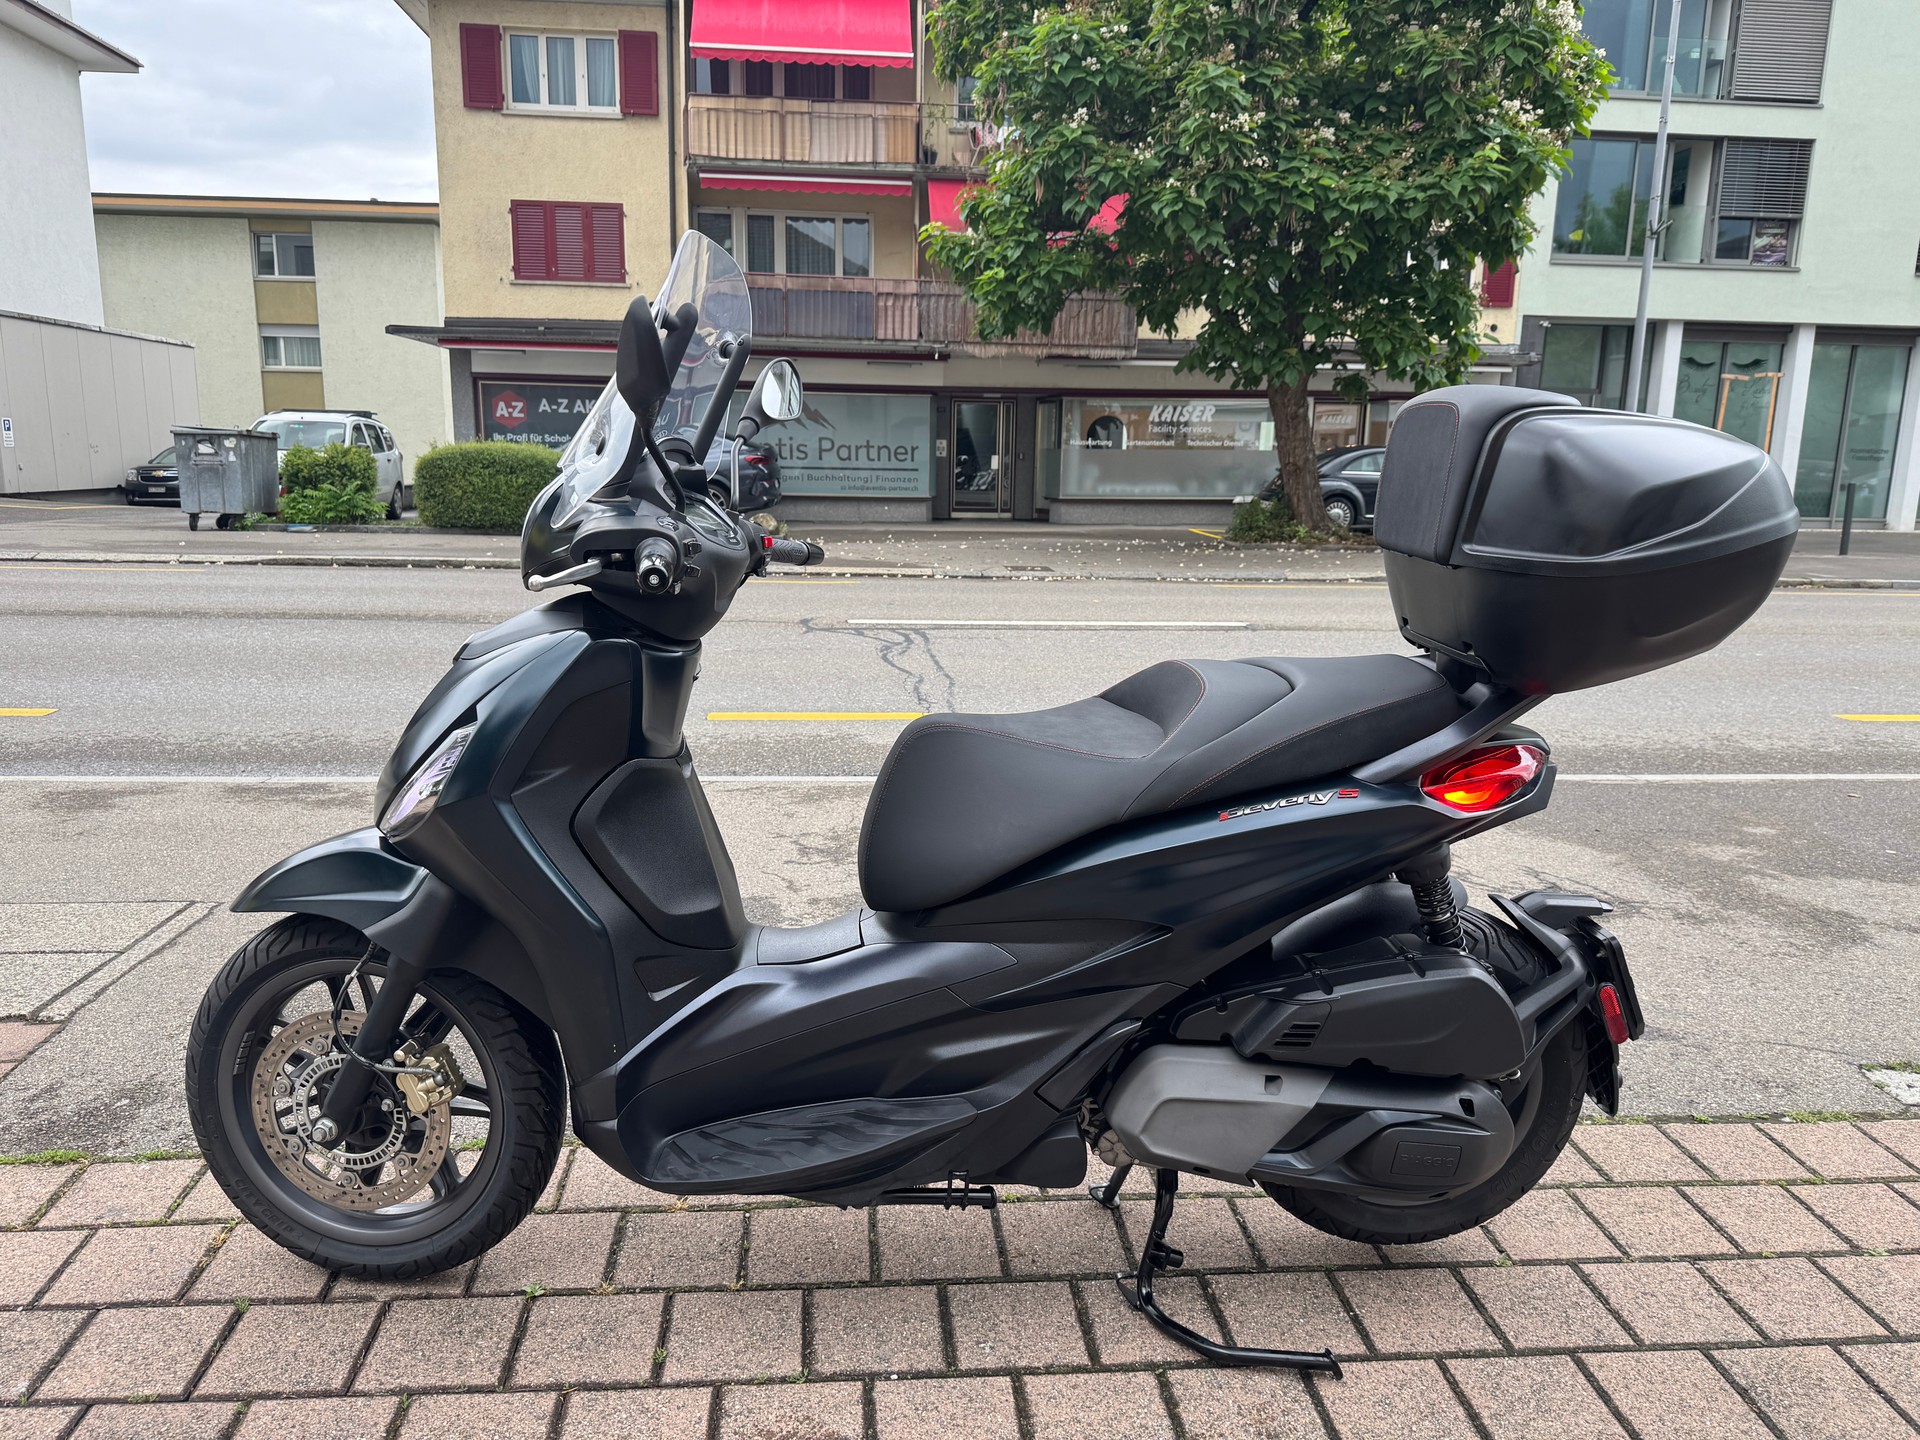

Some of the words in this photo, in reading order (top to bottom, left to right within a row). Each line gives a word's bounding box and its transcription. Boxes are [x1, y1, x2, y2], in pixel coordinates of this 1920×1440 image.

[496, 401, 525, 417] A-Z
[539, 398, 569, 413] A-Z
[1148, 404, 1216, 422] KAISER
[1320, 415, 1352, 424] KAISER
[1148, 424, 1177, 434] Facility
[1179, 424, 1212, 433] Services
[493, 432, 506, 441] Ihr
[507, 433, 528, 442] Profi
[529, 433, 542, 442] für
[1187, 439, 1223, 448] Technischer
[818, 437, 919, 463] Partner
[876, 475, 918, 484] Finanzen
[1218, 791, 1337, 822] Beverly
[1337, 788, 1360, 799] S
